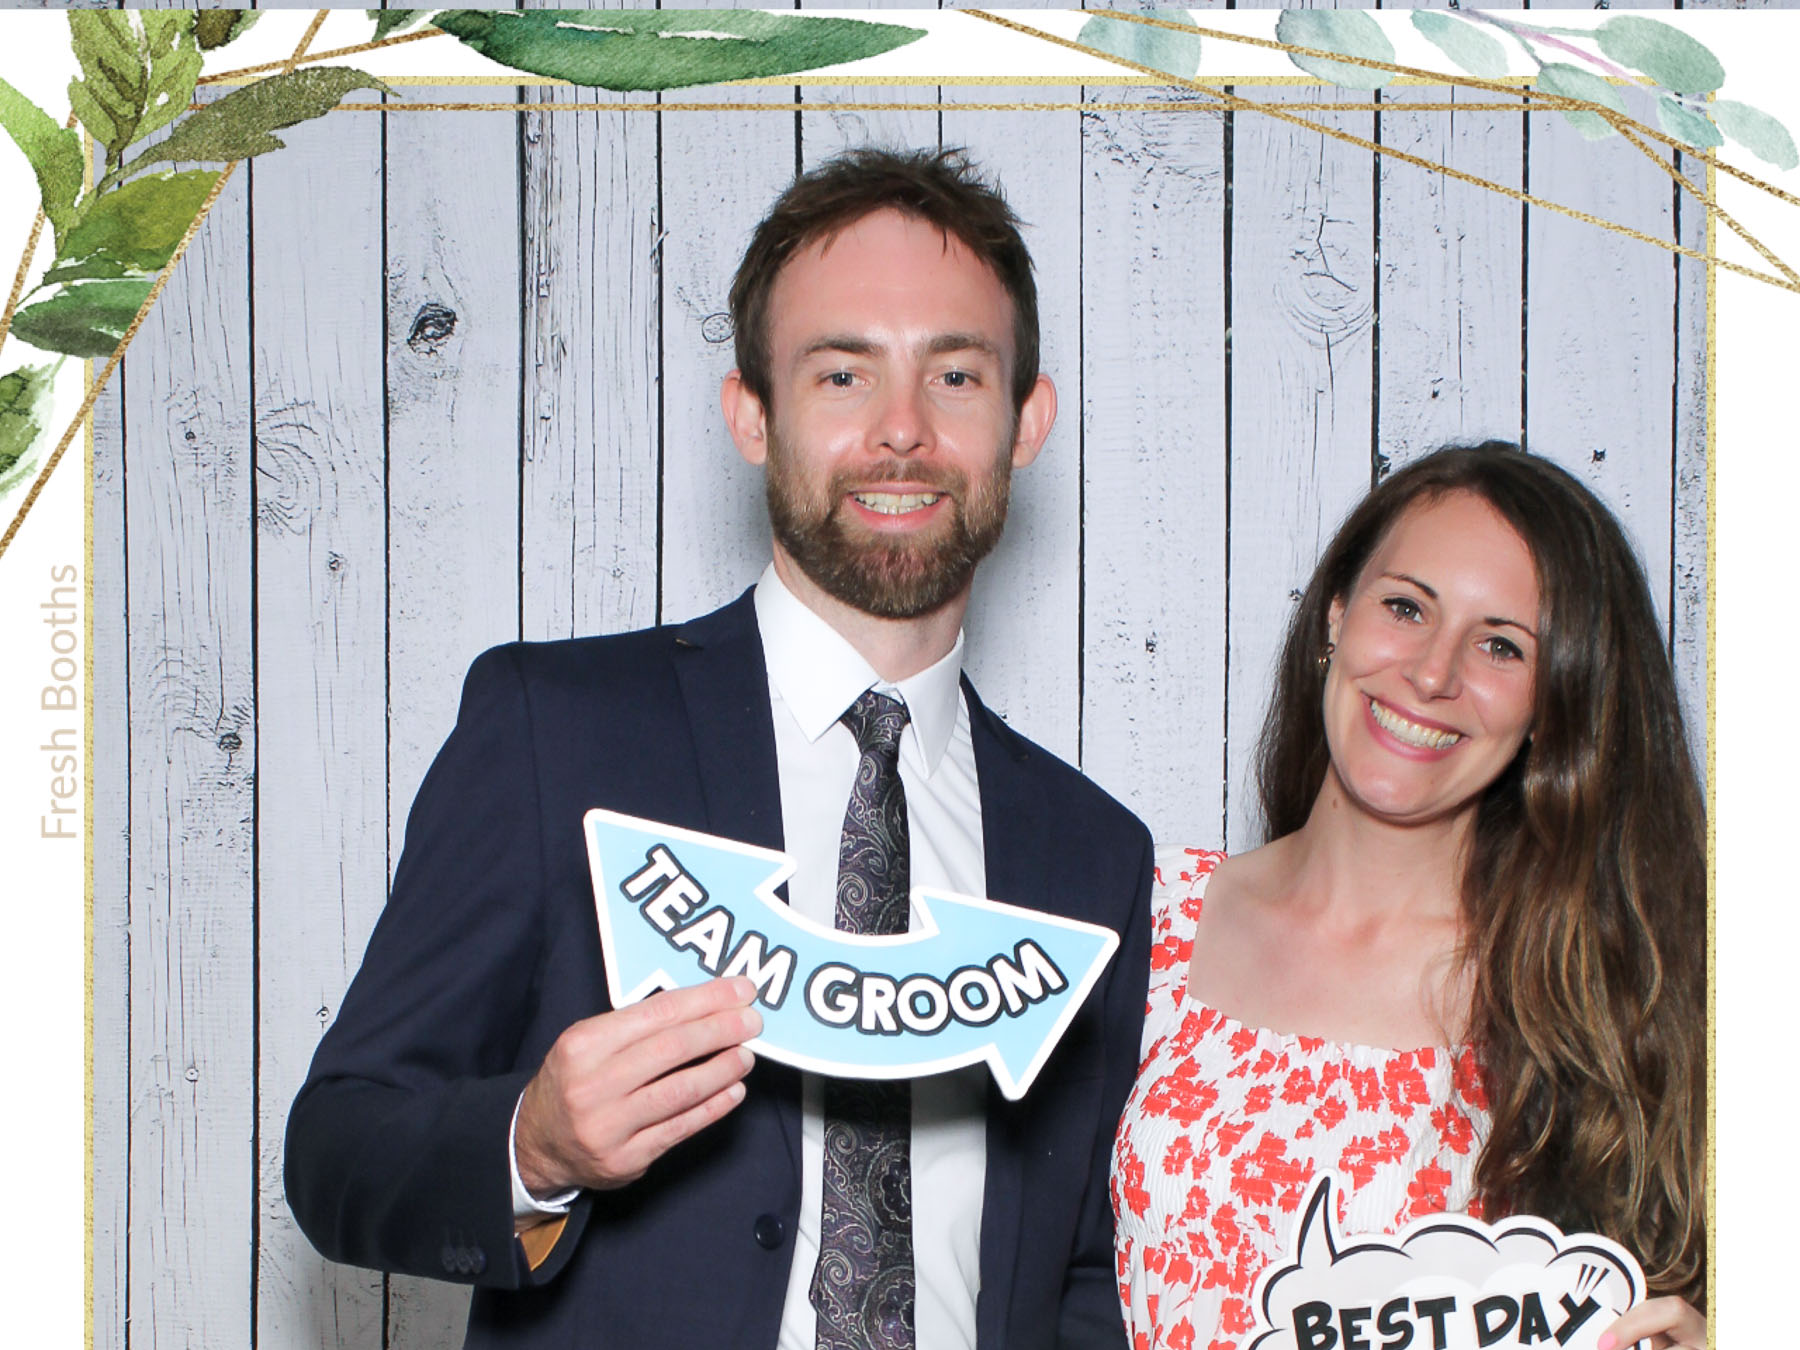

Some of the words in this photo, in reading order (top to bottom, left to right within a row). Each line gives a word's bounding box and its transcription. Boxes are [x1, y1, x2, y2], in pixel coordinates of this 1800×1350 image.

[619, 843, 797, 1010] TEAM
[804, 938, 1069, 1036] GROOM
[1473, 1292, 1601, 1349] DAY
